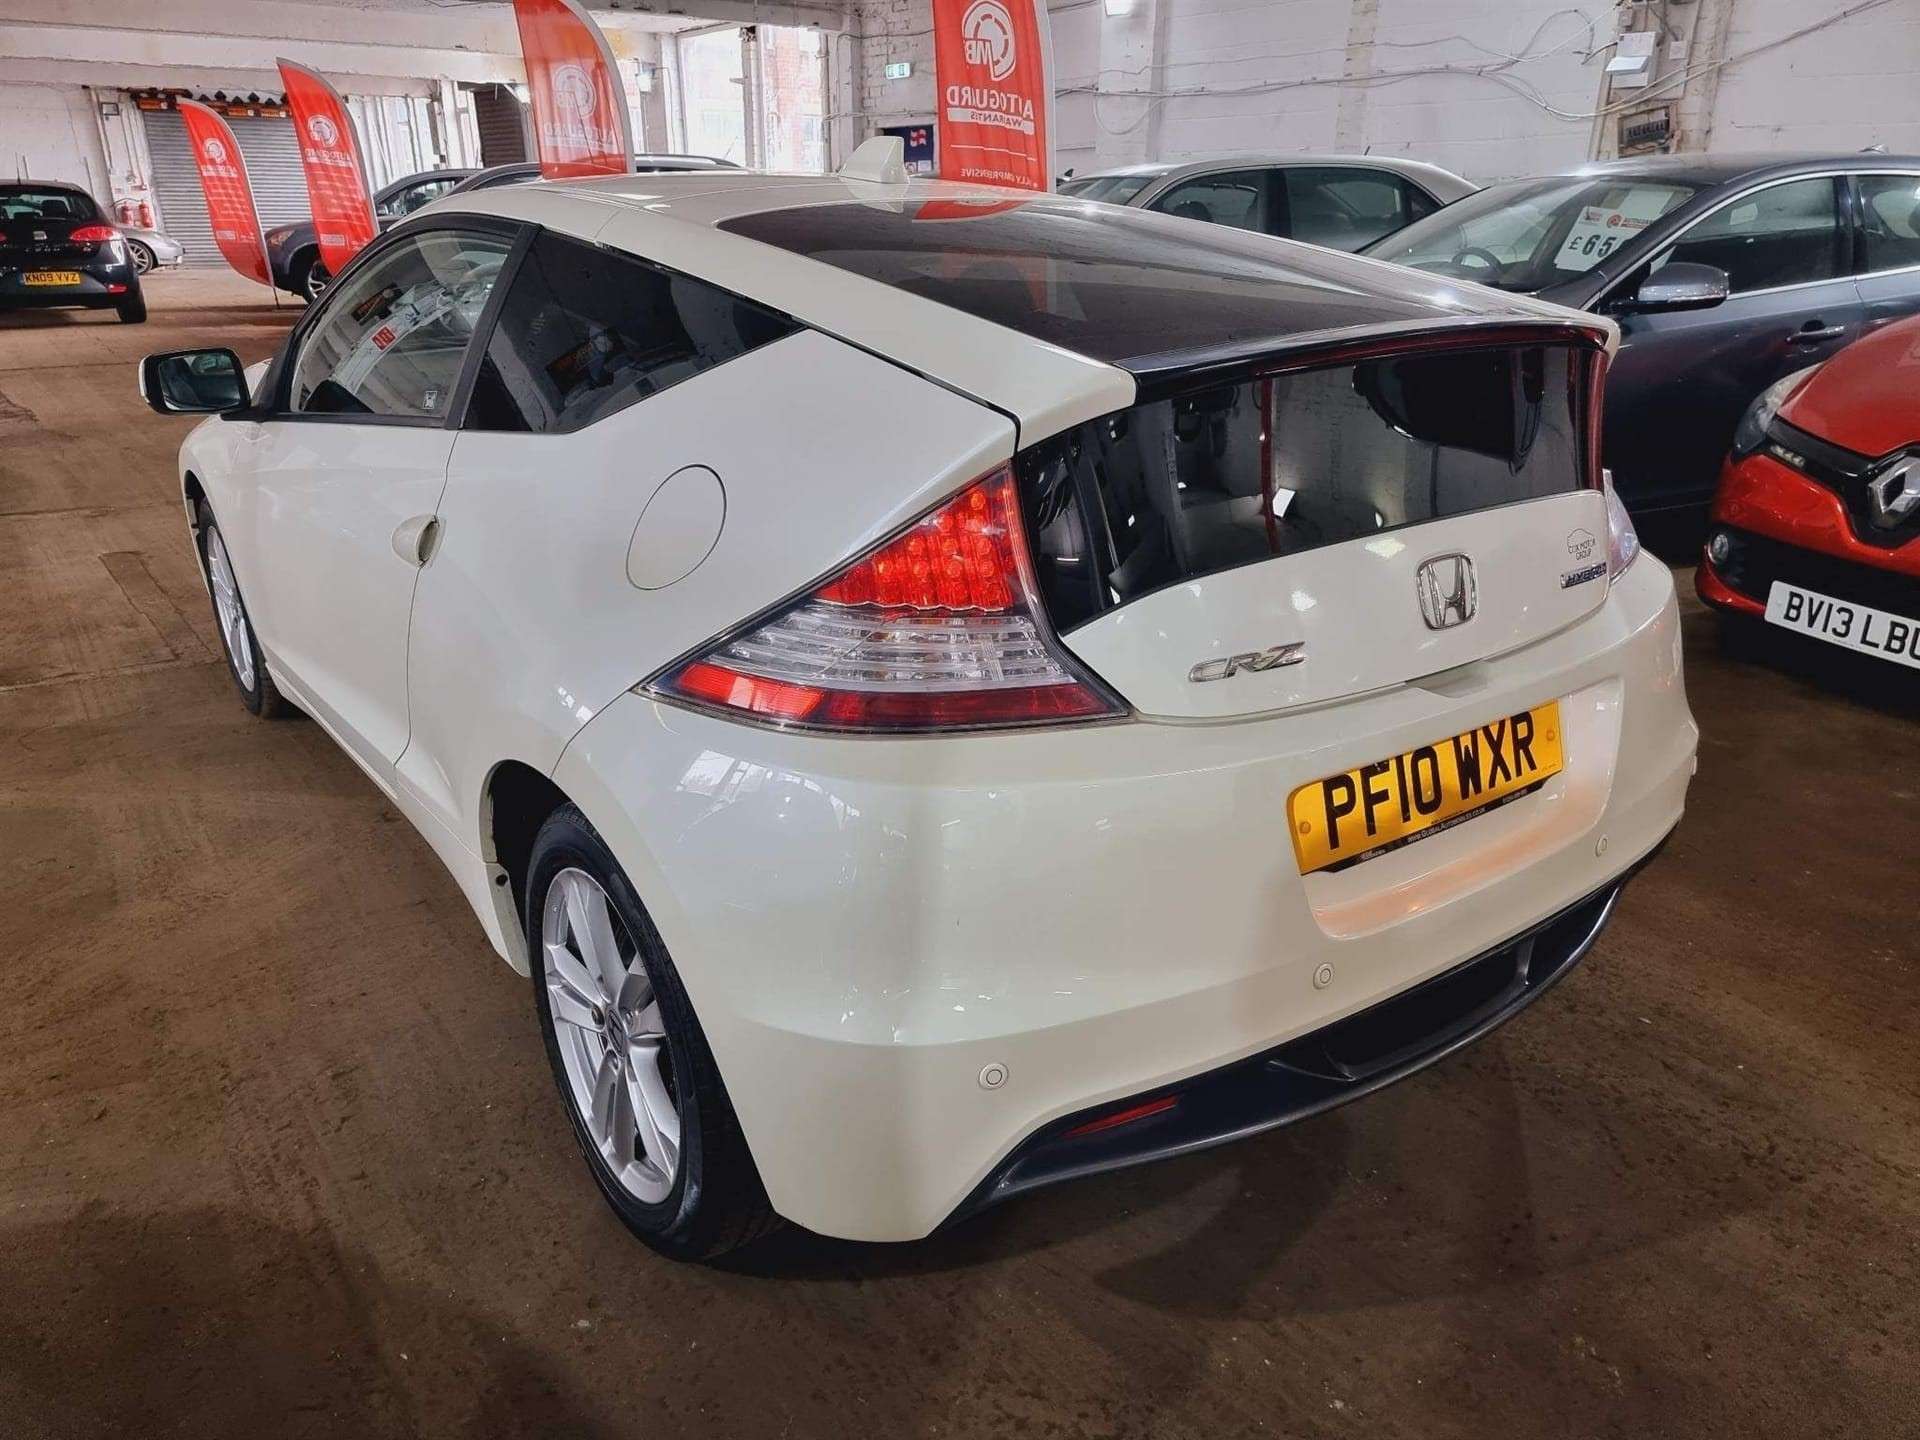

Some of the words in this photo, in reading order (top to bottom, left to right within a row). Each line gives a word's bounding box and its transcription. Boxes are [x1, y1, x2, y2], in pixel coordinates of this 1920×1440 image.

[1784, 591, 1854, 638] BV13
[1188, 641, 1305, 682] CR-Z
[1322, 745, 1442, 850] PF10
[1452, 711, 1538, 801] WXR
